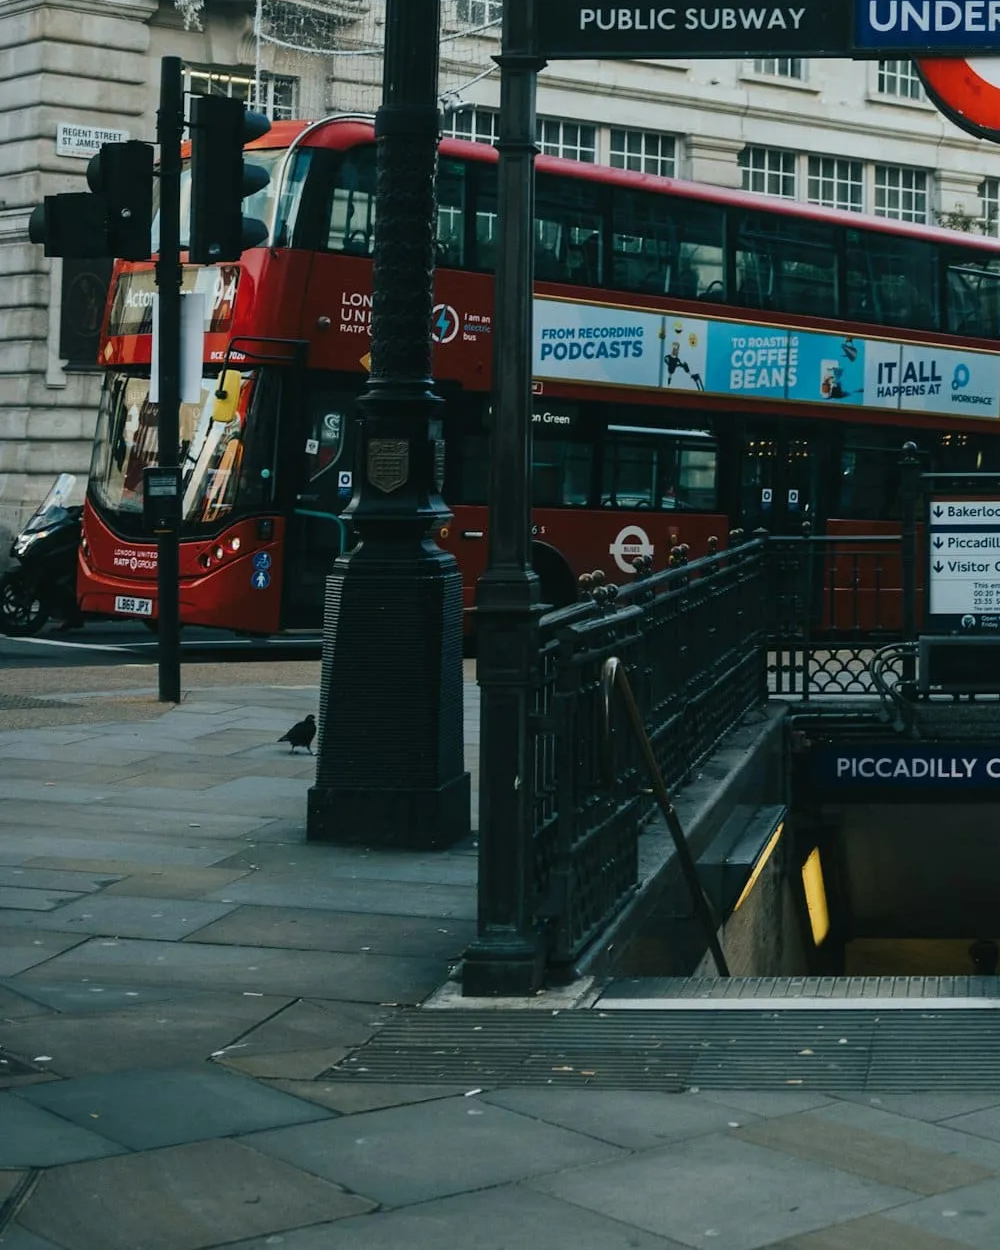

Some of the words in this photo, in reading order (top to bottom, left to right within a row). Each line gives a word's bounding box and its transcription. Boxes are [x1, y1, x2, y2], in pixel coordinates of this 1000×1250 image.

[580, 8, 676, 30] PUBLIC
[684, 8, 806, 30] SUBWAY
[62, 127, 92, 137] REGENT
[94, 131, 122, 141] STREET
[342, 292, 373, 307] LON
[341, 308, 372, 323] UNI
[464, 313, 468, 321] I
[340, 324, 365, 334] RATP
[464, 323, 491, 333] electric
[541, 328, 575, 339] FROM
[578, 327, 644, 338] RECORDING
[463, 333, 477, 341] bus
[731, 337, 746, 348] TO
[748, 336, 799, 348] ROASTING
[540, 340, 643, 360] PODCASTS
[731, 348, 799, 368] COFFEE
[730, 367, 797, 390] BEANS
[877, 362, 897, 384] IT
[903, 360, 942, 383] ALL
[877, 385, 925, 398] HAPPENS
[928, 383, 942, 395] AT
[951, 394, 993, 406] WORKSPACE
[543, 412, 570, 425] Green
[115, 549, 136, 557] LONDON
[137, 551, 158, 559] UNITED
[114, 557, 130, 567] RATP
[137, 559, 158, 569] GROUP
[948, 561, 990, 572] Visitor
[837, 758, 978, 778] PICCADILLY
